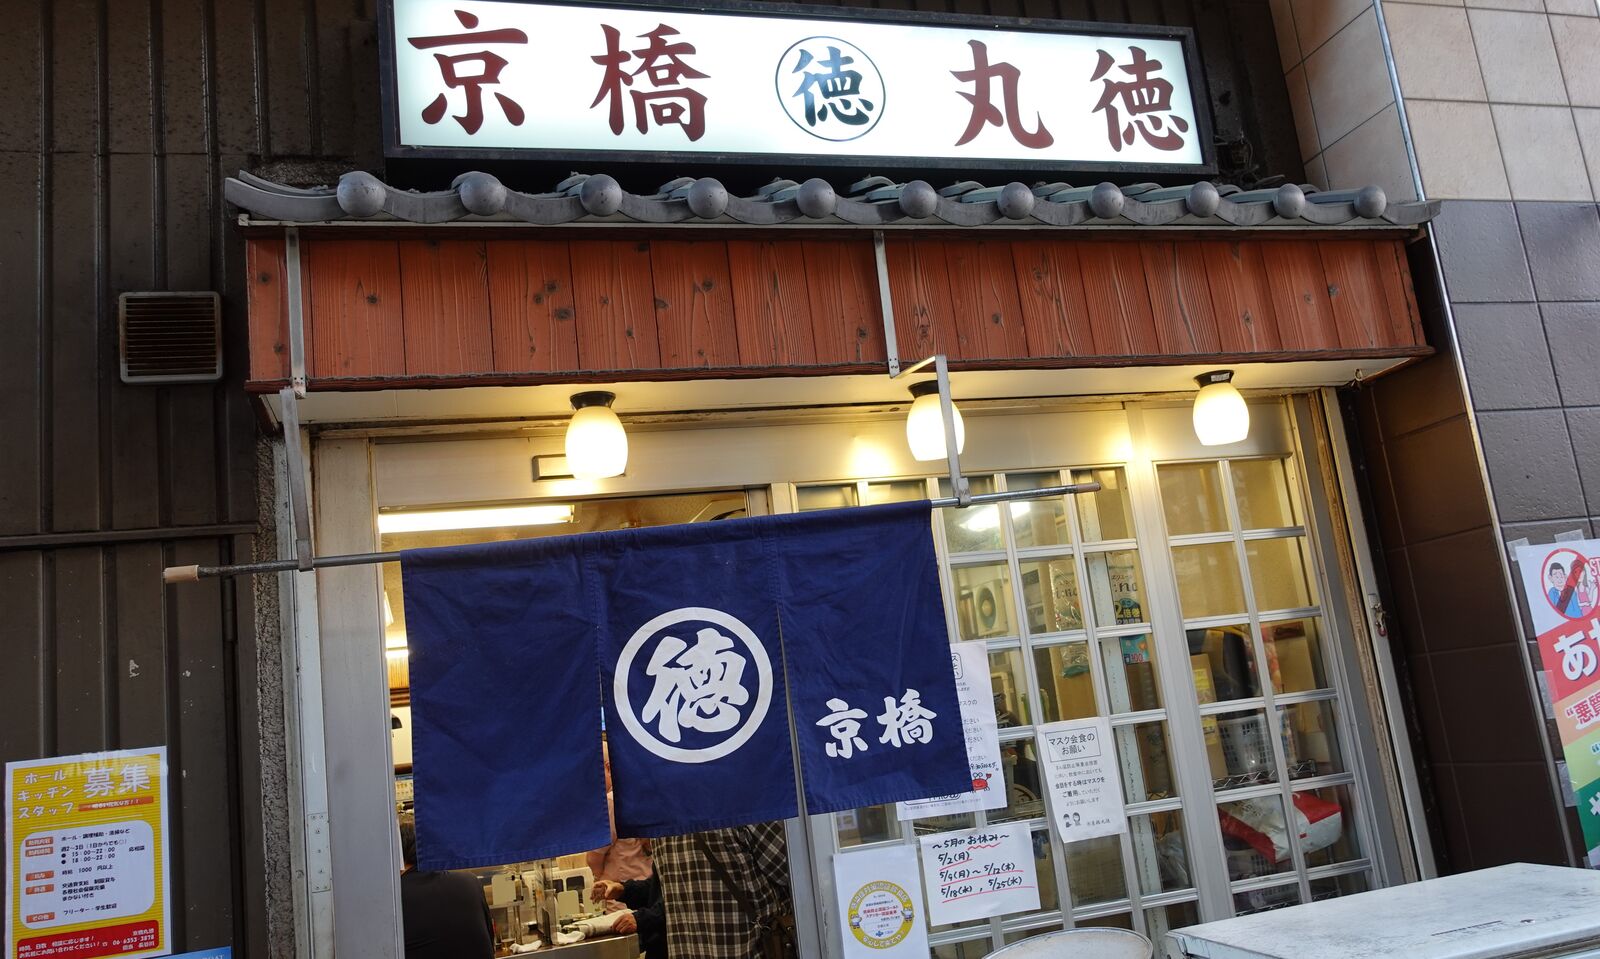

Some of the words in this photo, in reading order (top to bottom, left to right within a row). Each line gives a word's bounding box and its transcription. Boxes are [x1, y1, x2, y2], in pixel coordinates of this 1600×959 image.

[792, 46, 875, 128] 徳
[1553, 618, 1600, 681] あ
[641, 627, 750, 743] 徳
[816, 688, 937, 760] 京橋
[1048, 732, 1096, 746] マスク会食の
[1061, 744, 1087, 755] お願い
[25, 769, 67, 785] ホール
[83, 763, 151, 799] 募集
[17, 785, 74, 802] キッチン
[18, 802, 74, 819] スタッフ
[938, 851, 970, 866] 5/2(月)
